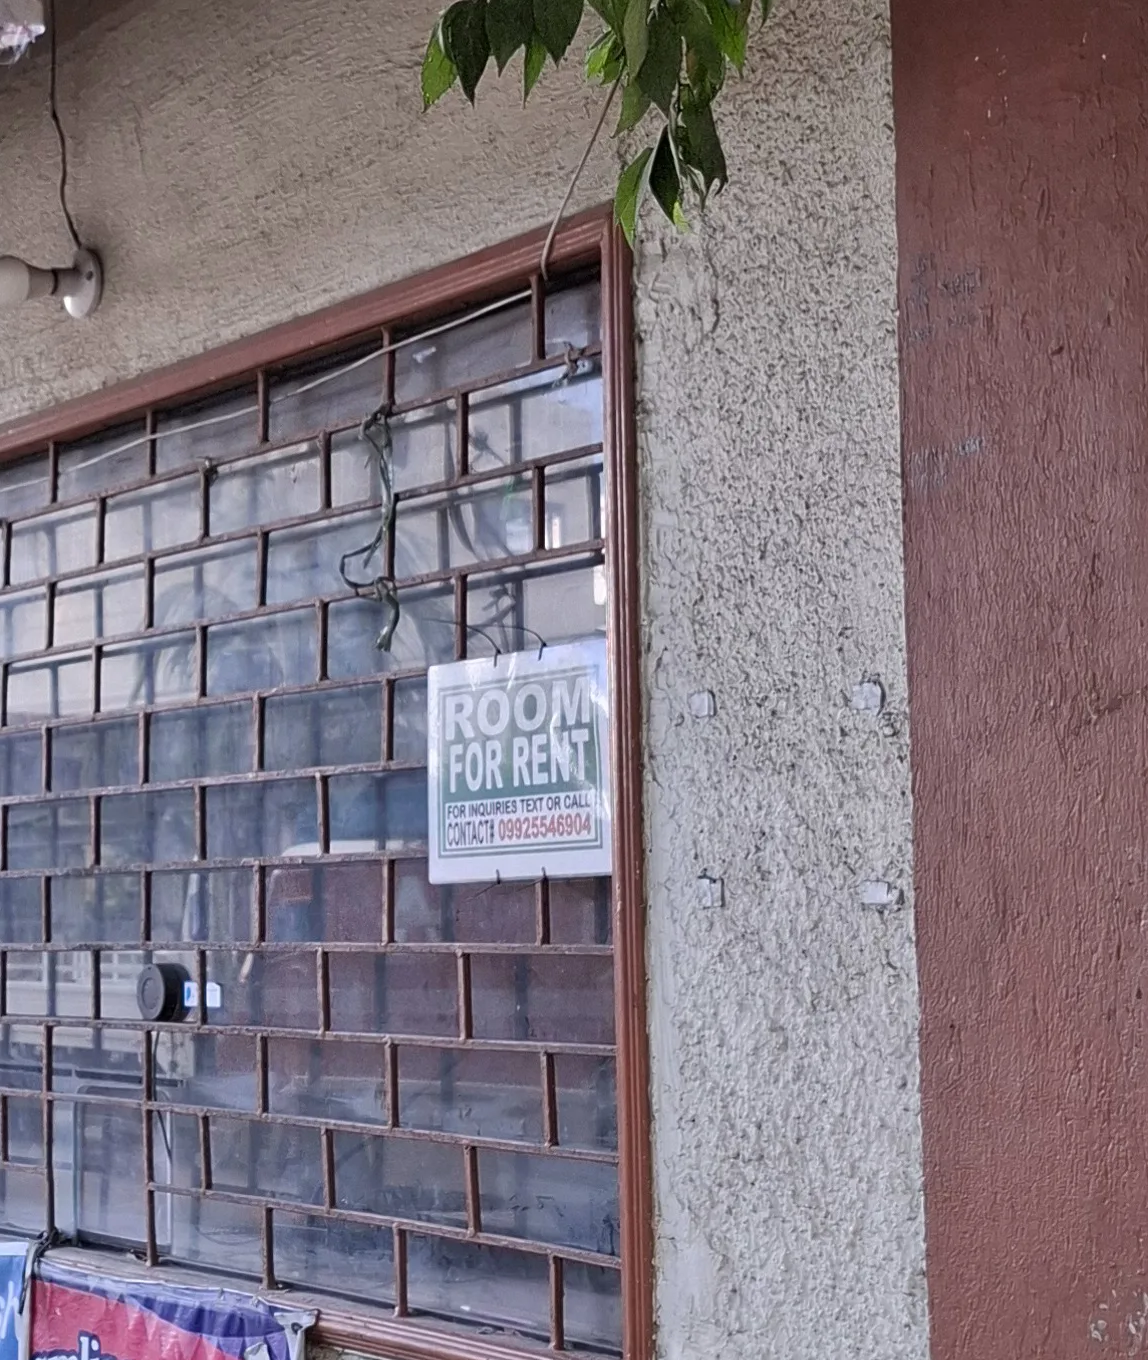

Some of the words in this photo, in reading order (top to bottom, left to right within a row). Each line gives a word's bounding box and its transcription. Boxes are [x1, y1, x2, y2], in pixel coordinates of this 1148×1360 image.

[445, 678, 591, 740] ROOM
[449, 740, 503, 794] FOR
[513, 728, 589, 788] RENT
[447, 807, 466, 820] FOR
[469, 802, 518, 818] INQUIRIES
[521, 797, 544, 813] TEXT
[546, 795, 562, 811] OR
[564, 792, 591, 810] CALL
[447, 818, 495, 847] CONTACT#
[498, 812, 592, 842] 09925546904
